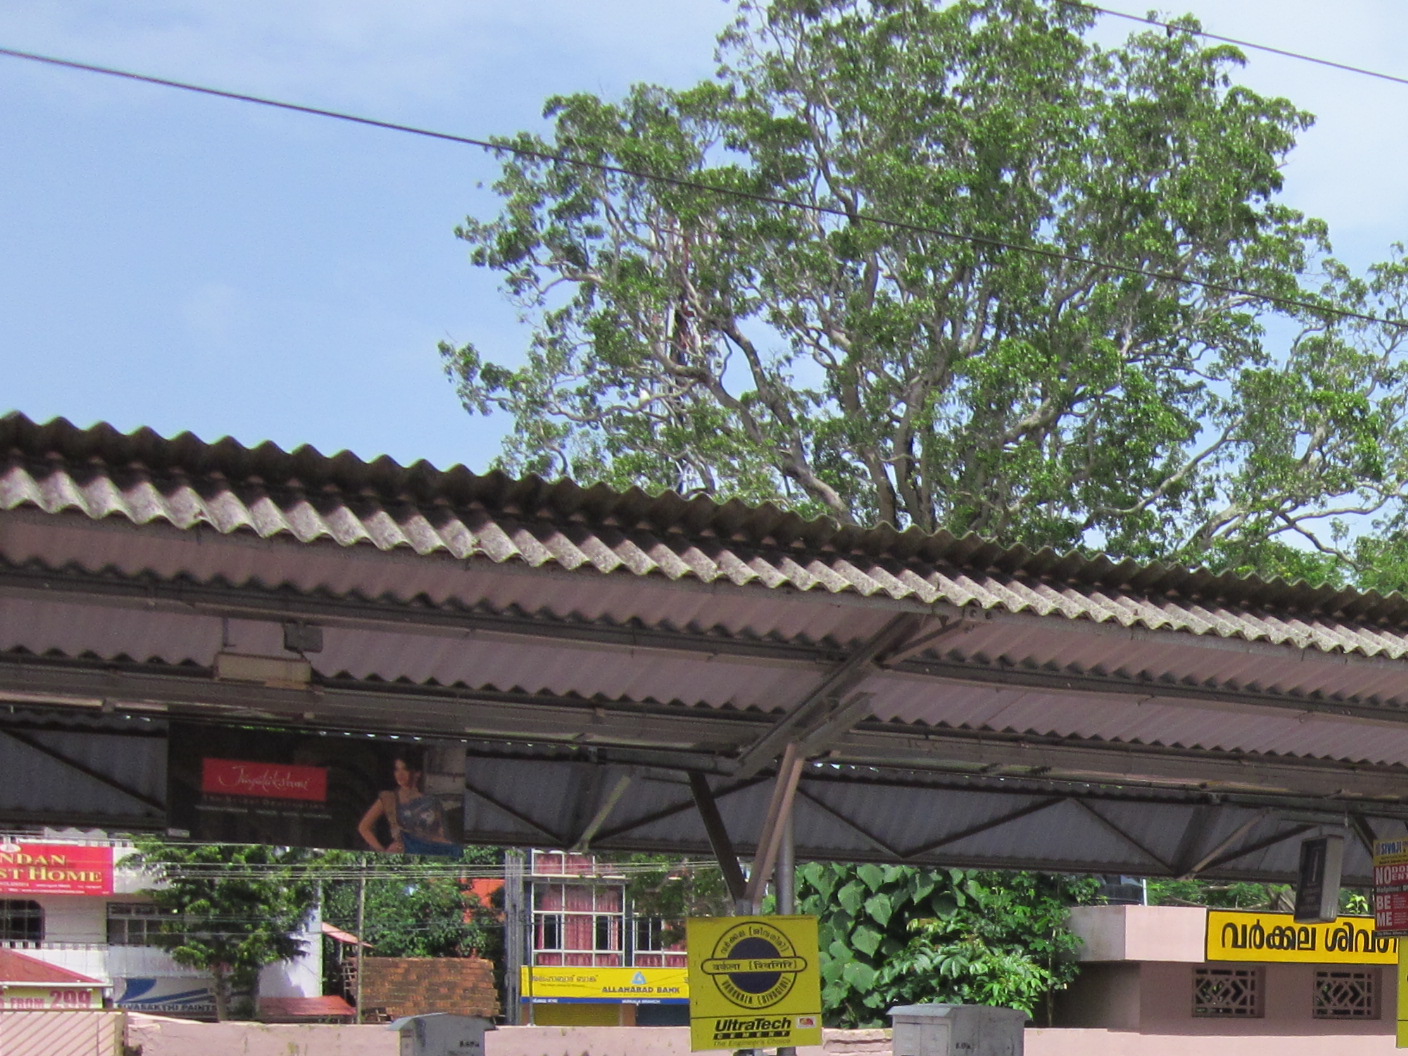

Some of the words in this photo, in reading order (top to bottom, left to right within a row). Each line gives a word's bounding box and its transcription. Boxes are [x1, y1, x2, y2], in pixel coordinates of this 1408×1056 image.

[29, 866, 103, 882] HOME
[1375, 865, 1392, 886] NO
[1376, 895, 1392, 910] BE
[1376, 911, 1393, 927] ME
[1221, 919, 1317, 951] വർക്കല
[602, 986, 653, 994] ALLAHABAD
[656, 986, 680, 994] BANK
[715, 1017, 792, 1032] UltraTech
[715, 1031, 790, 1039] CEMENT
